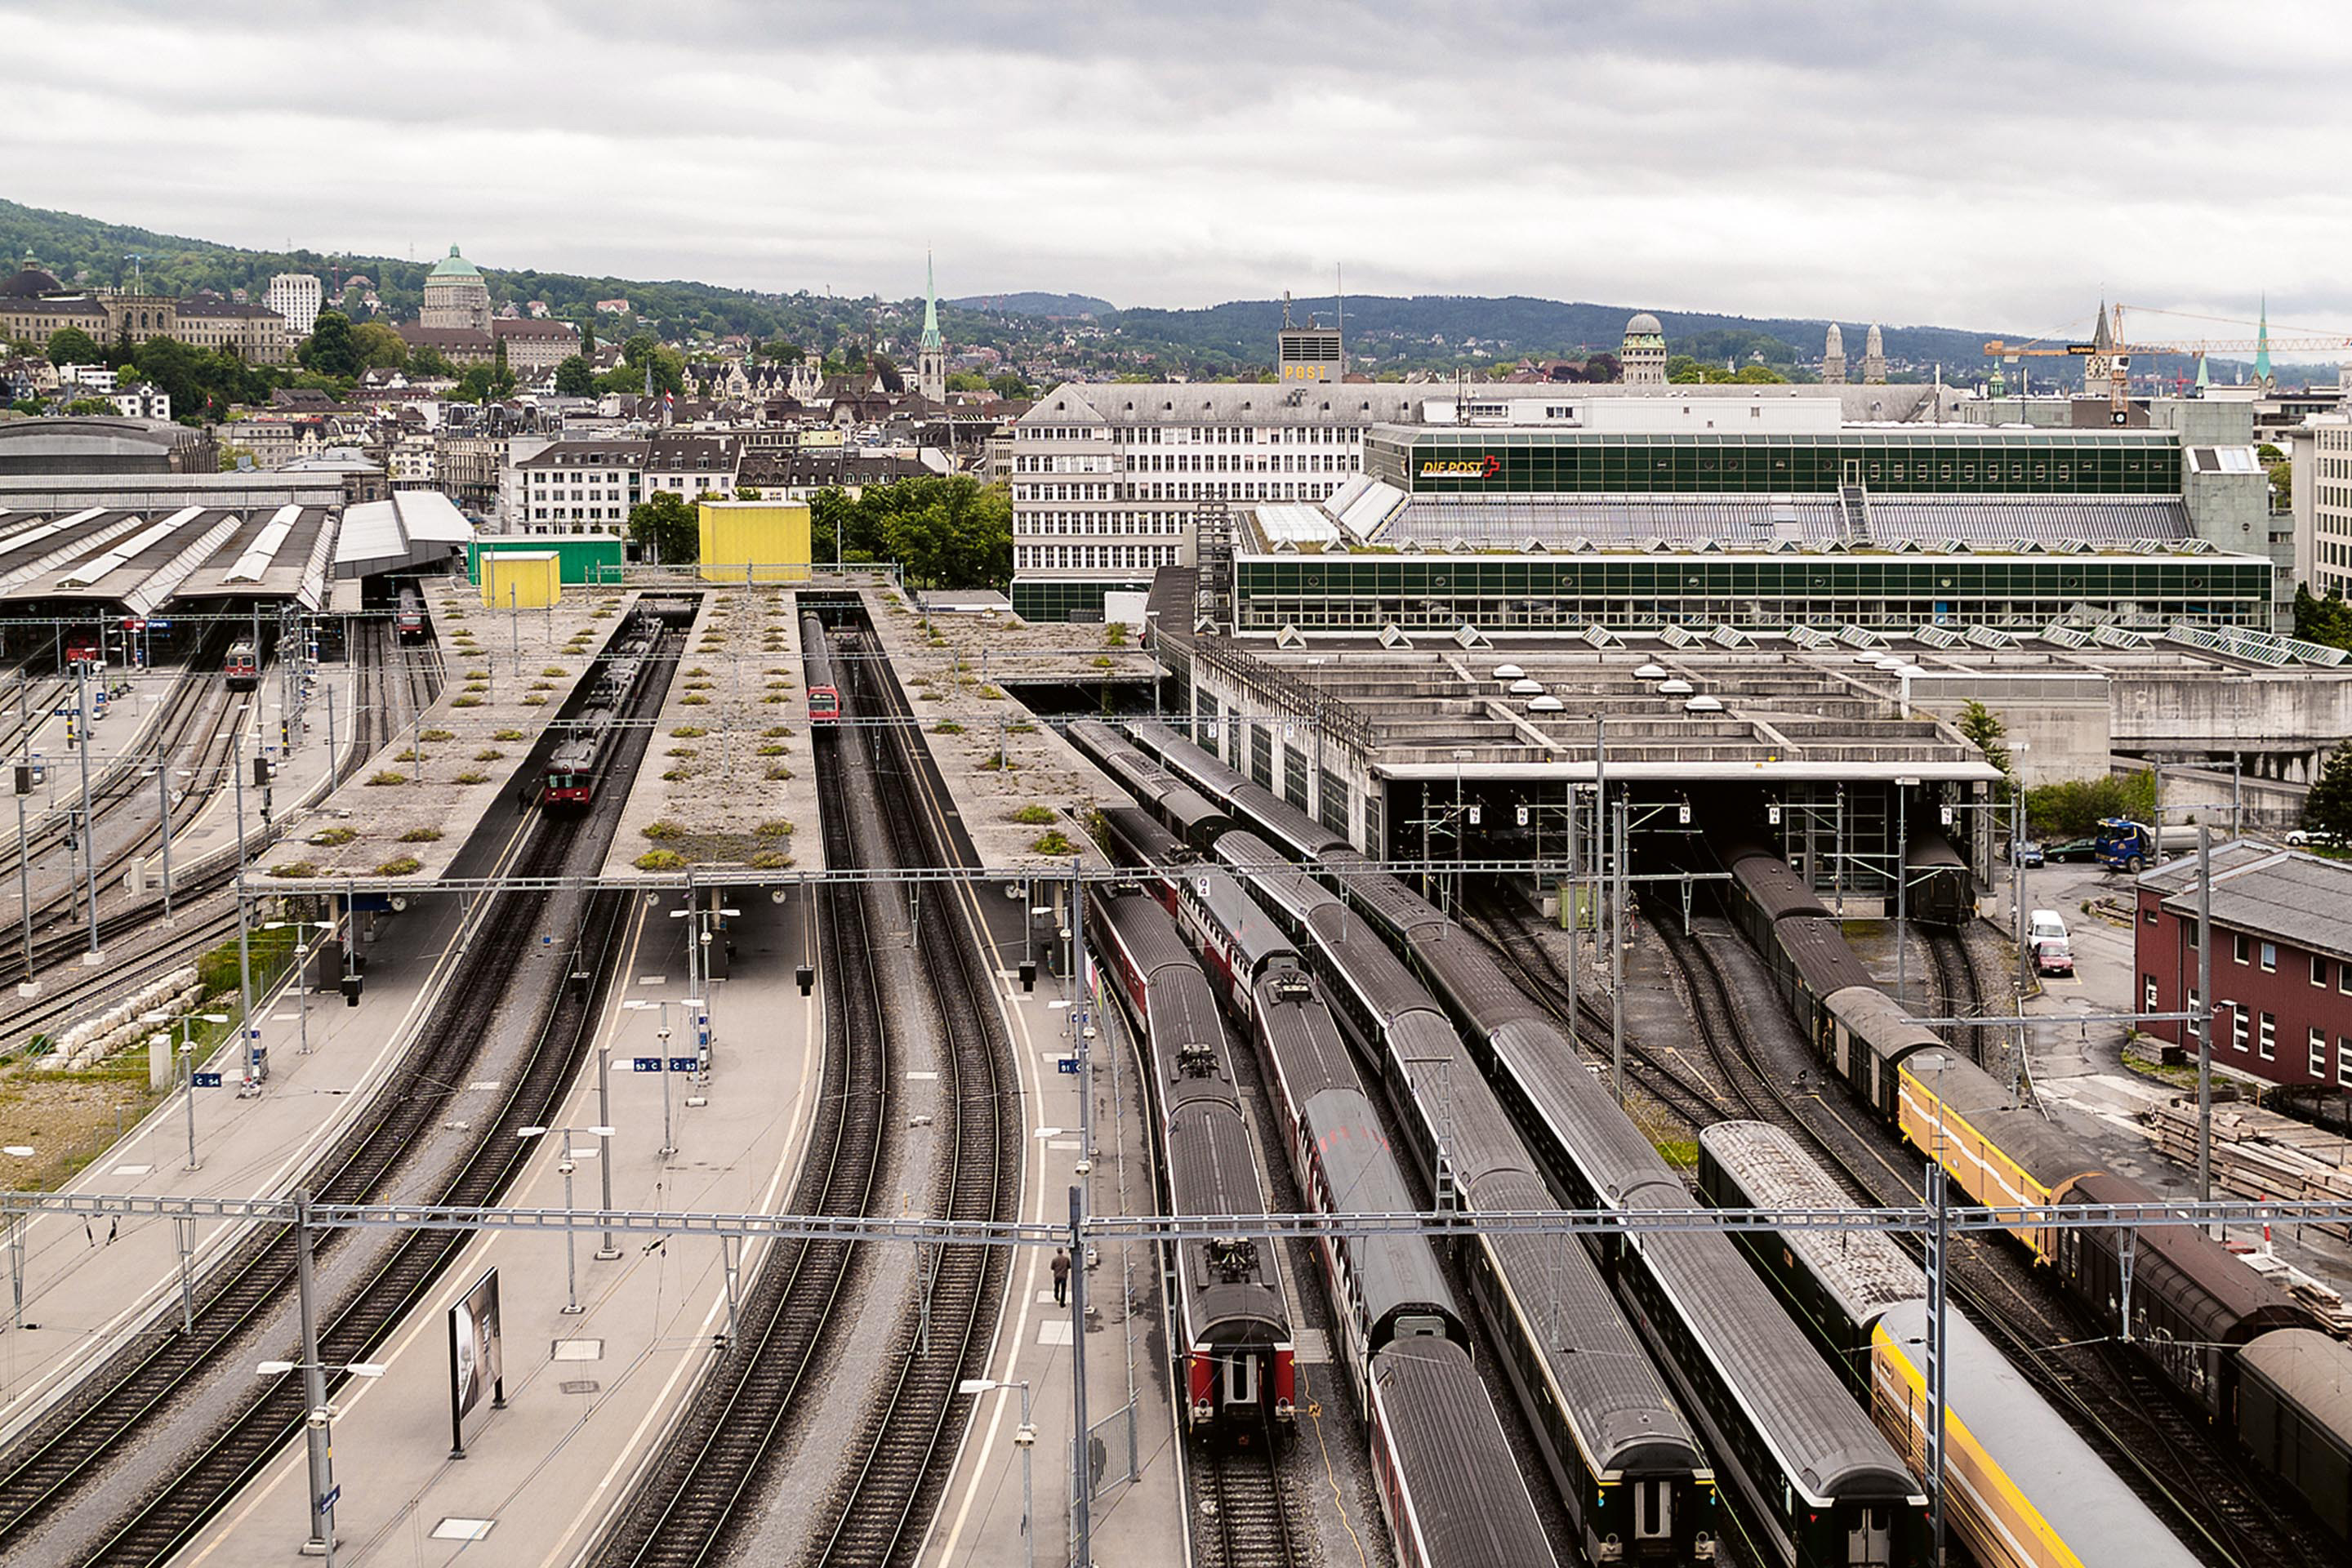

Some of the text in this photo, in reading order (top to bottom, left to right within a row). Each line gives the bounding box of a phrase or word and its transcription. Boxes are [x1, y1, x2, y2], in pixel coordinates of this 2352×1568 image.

[1285, 365, 1326, 380] POST
[1423, 461, 1484, 474] DIE POST
[651, 1062, 657, 1070] C
[673, 1062, 680, 1070] C
